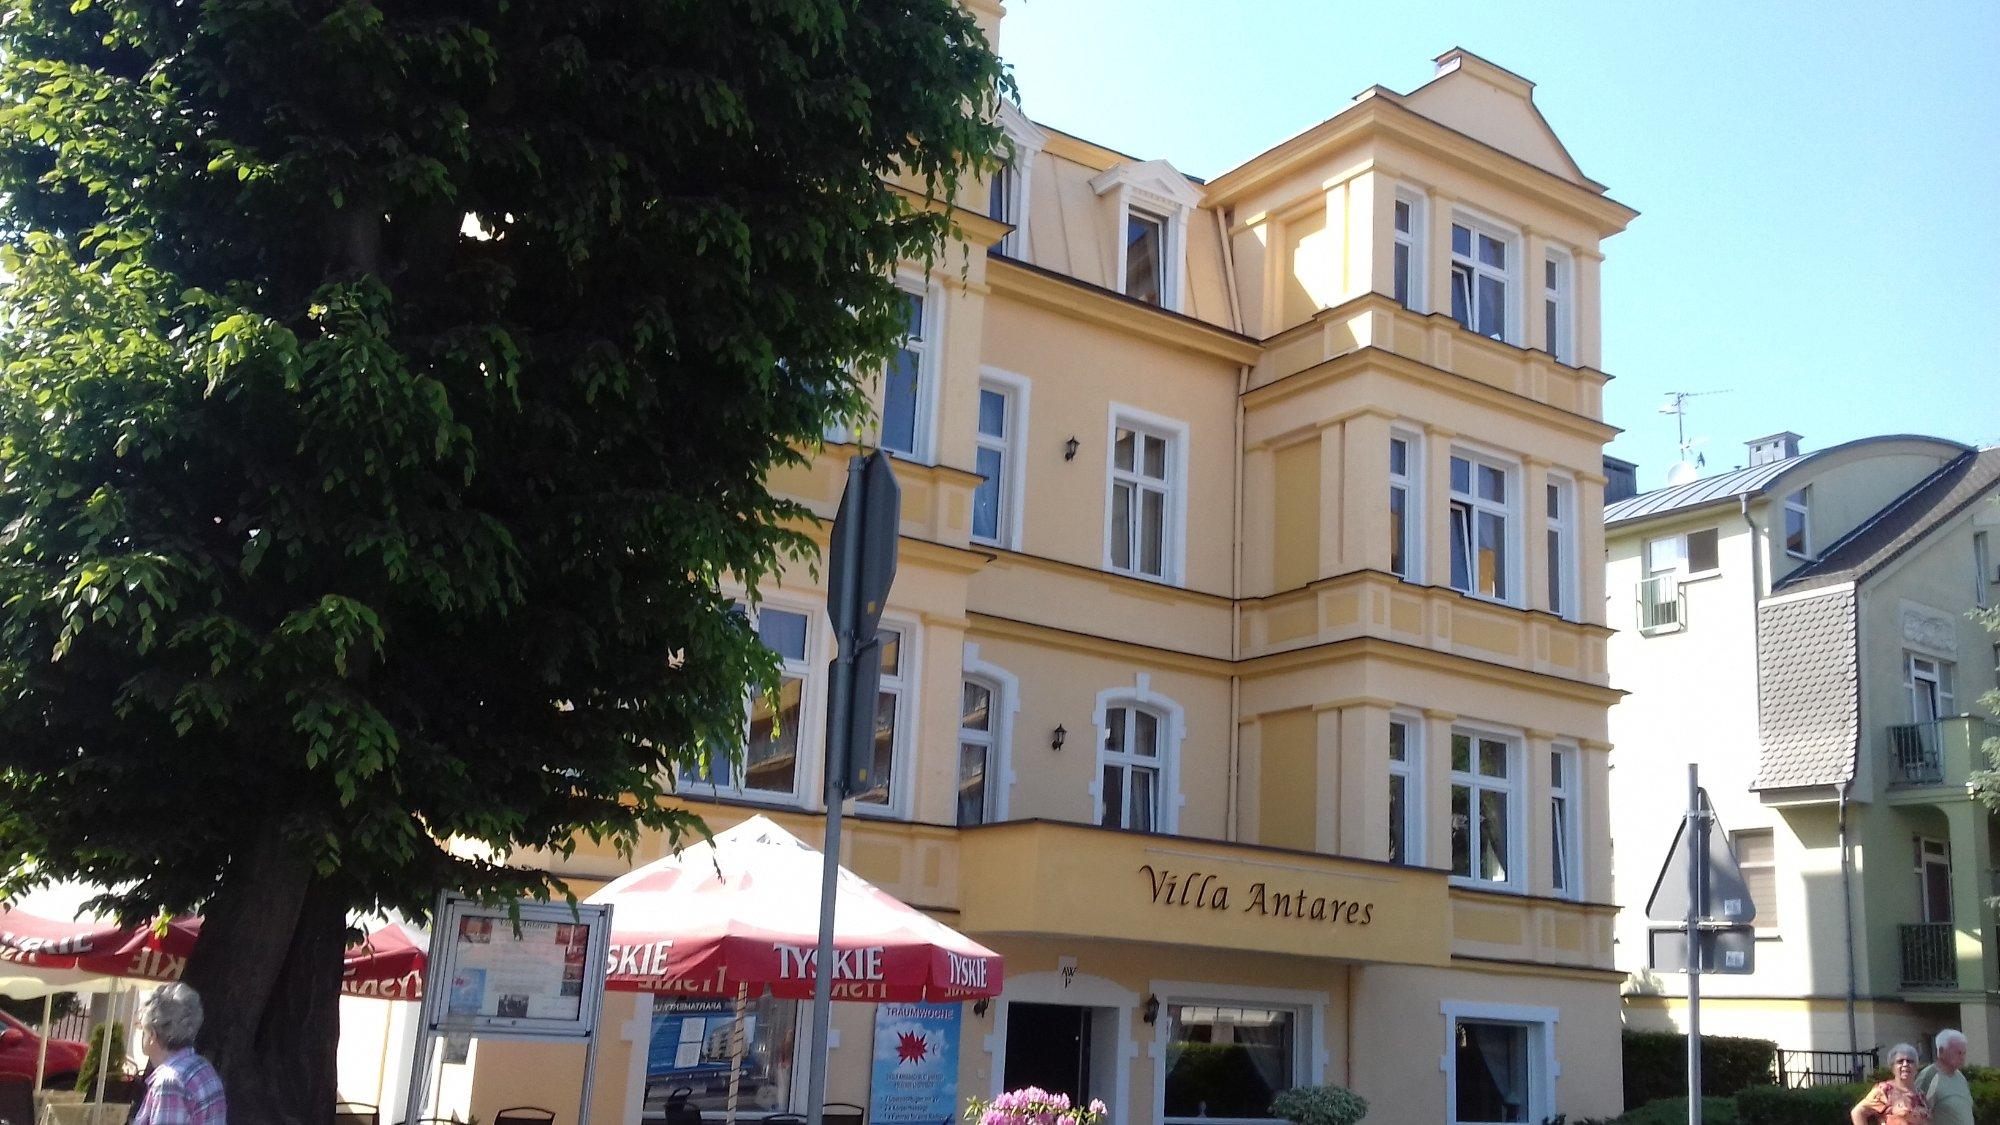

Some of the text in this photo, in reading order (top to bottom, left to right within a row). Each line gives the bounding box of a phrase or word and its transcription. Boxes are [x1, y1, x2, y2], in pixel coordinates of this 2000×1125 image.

[1138, 864, 1374, 926] Villa Antares
[947, 950, 988, 989] TYSKIE
